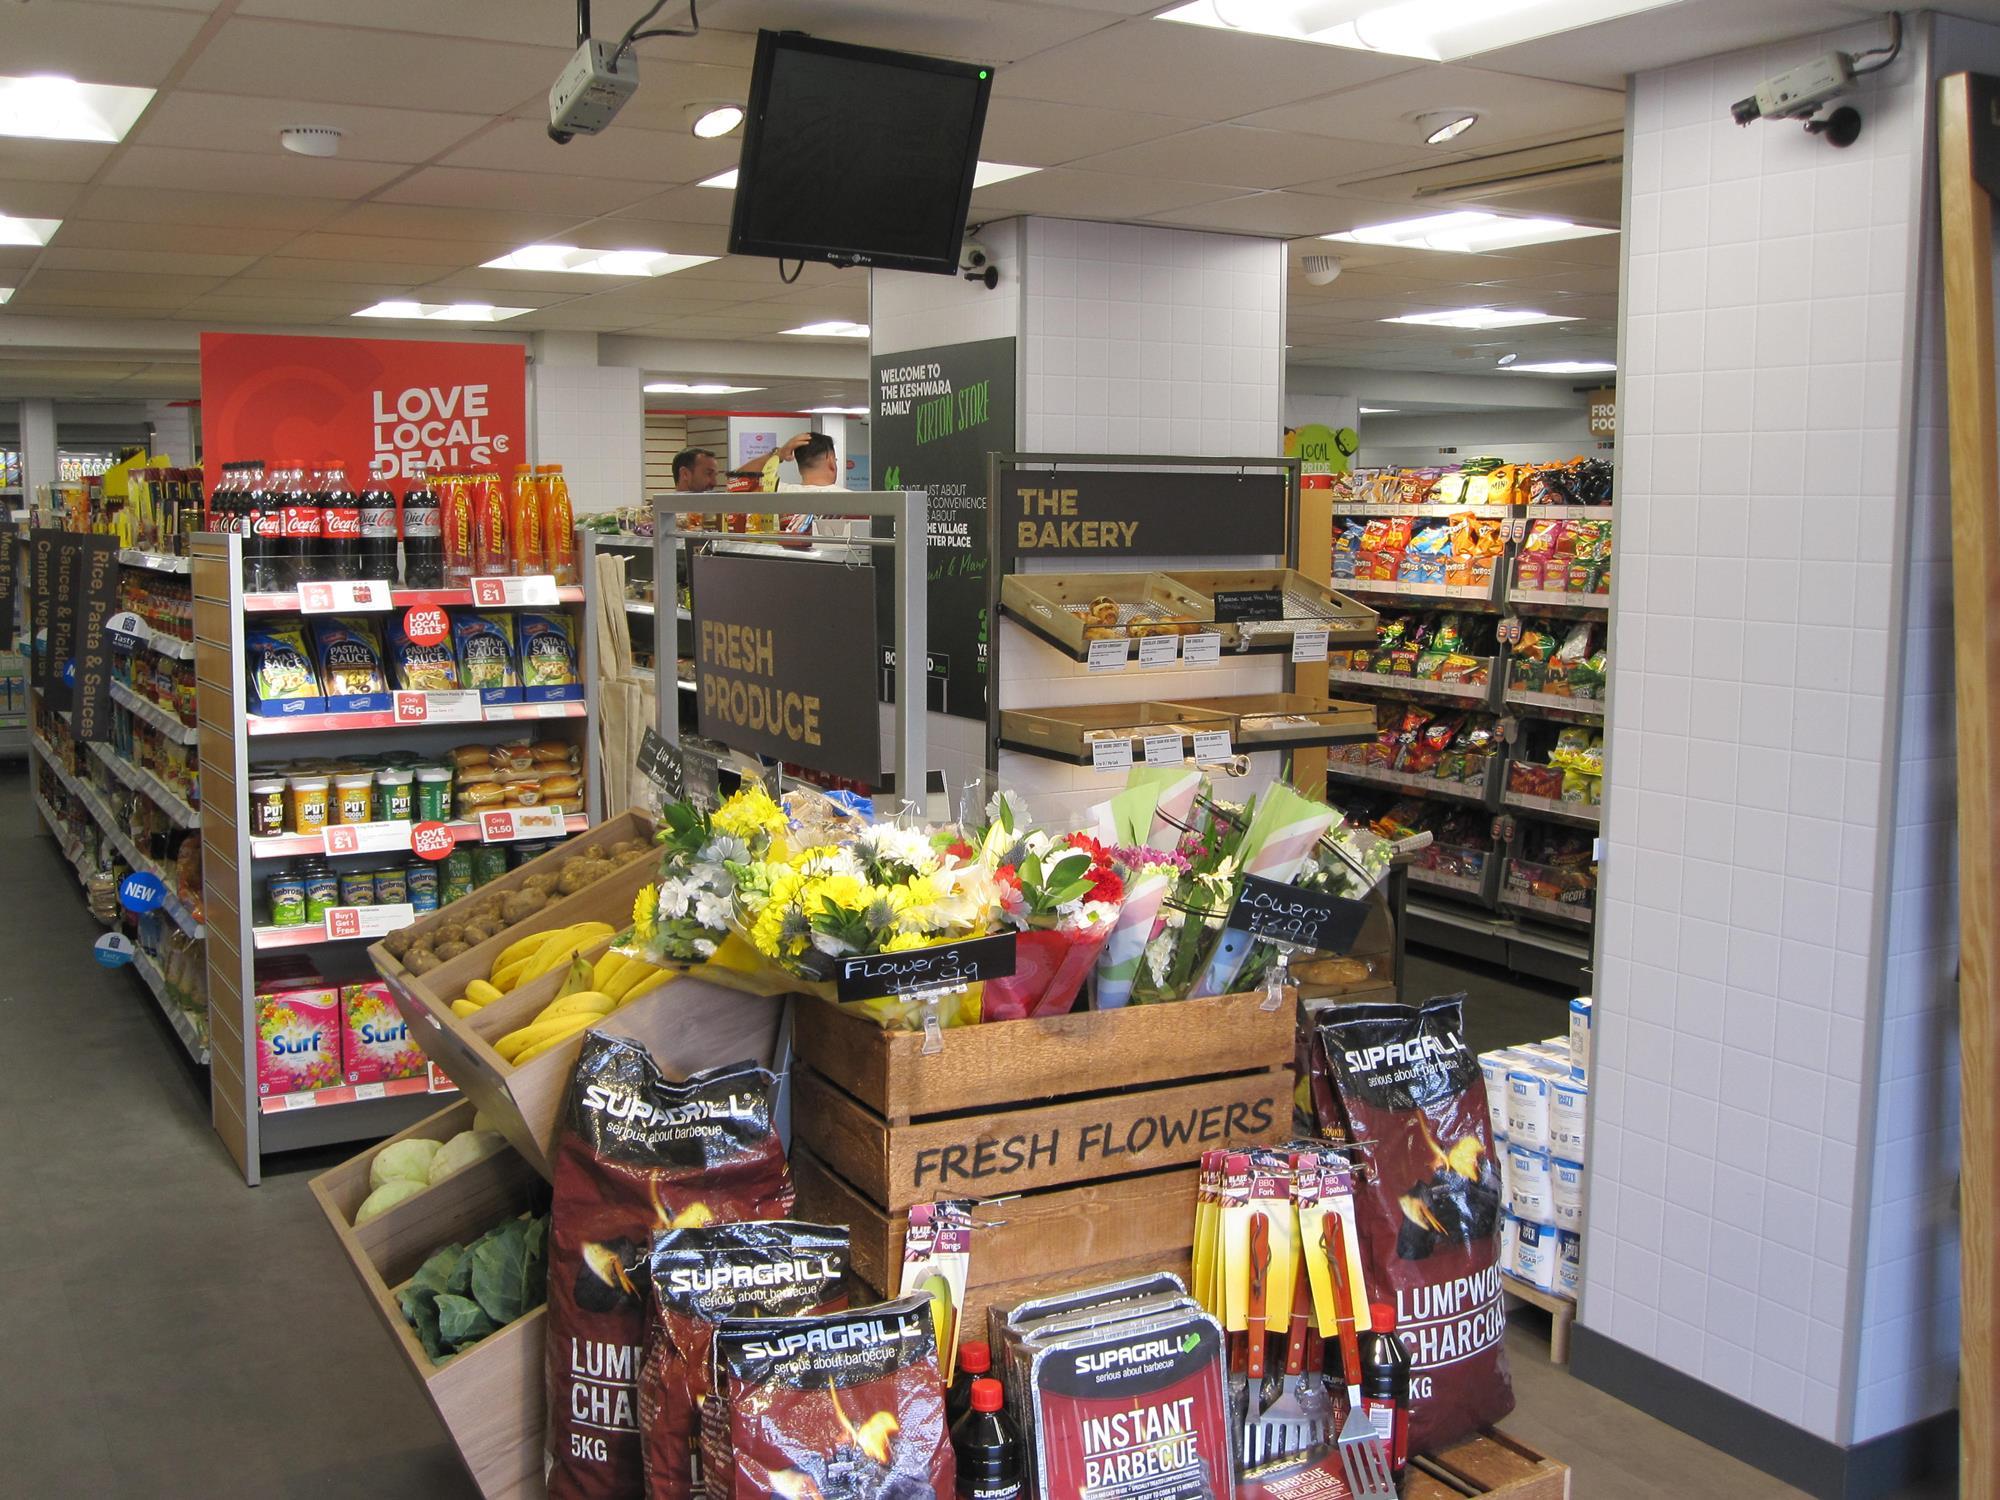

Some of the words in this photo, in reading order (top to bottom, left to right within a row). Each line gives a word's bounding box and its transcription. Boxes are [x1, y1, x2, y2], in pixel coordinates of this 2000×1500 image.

[880, 365, 926, 384] WELCOME
[927, 363, 940, 379] TO
[880, 384, 898, 400] THE
[900, 380, 952, 398] KESHWARA
[373, 384, 489, 424] LOVE
[881, 400, 912, 416] FAMILY
[1592, 404, 1616, 416] FRO
[916, 394, 954, 446] KIRTON
[958, 380, 990, 431] STORE
[1592, 418, 1616, 431] FOO
[374, 418, 490, 452] LOCAL
[1302, 443, 1330, 462] LOCAL
[1302, 462, 1330, 473] PRIDE
[941, 484, 966, 496] ABOUT
[932, 497, 987, 509] CONVENIENCE
[1017, 488, 1079, 516] THE
[932, 510, 956, 522] ABOUT
[926, 523, 937, 534] HE
[938, 523, 968, 534] VILLAGE
[1018, 521, 1140, 548] BAKERY
[948, 536, 972, 548] PLACE
[58, 546, 76, 602] Sauces
[482, 590, 500, 602] £1
[57, 608, 72, 618] &
[409, 611, 441, 622] LOVE
[86, 600, 106, 650] Pasta
[410, 620, 442, 629] LOCAL
[410, 626, 442, 638] DEALS
[114, 633, 136, 646] Tasty
[468, 637, 495, 647] PASTA
[532, 637, 560, 647] PASTA
[330, 645, 358, 655] PASTA
[468, 646, 506, 658] SAUCE
[702, 620, 774, 677] FRESH
[84, 655, 102, 668] &
[330, 653, 371, 664] SAUCE
[406, 652, 444, 664] SAUCE
[80, 673, 102, 738] Sauces
[401, 705, 424, 717] 75p
[703, 672, 822, 746] PRODUCE
[304, 802, 325, 814] POT
[344, 800, 366, 812] POT
[392, 796, 410, 808] POT
[264, 804, 282, 817] POT
[414, 827, 446, 840] LOVE
[488, 825, 512, 834] £1.50
[334, 836, 352, 849] £1
[416, 835, 446, 846] LOCAL
[417, 842, 448, 853] DEALS
[124, 882, 156, 902] NEW
[334, 912, 348, 921] Buy
[336, 926, 356, 934] Free
[361, 1022, 408, 1044] Surf
[272, 1032, 323, 1056] Surf
[1368, 1073, 1393, 1088] serious
[1394, 1066, 1420, 1082] about
[582, 1084, 755, 1128] SUPAGRILL
[606, 1122, 646, 1142] serious
[650, 1130, 673, 1144] about
[674, 1124, 722, 1140] barbecue
[914, 1128, 1059, 1188] FRESH
[1078, 1098, 1275, 1162] FLOWERS
[1258, 1178, 1275, 1188] BBQ
[1324, 1176, 1339, 1184] BBQ
[1258, 1188, 1275, 1196] Fork
[1325, 1186, 1348, 1195] Spatula
[941, 1232, 957, 1240] BBQ
[940, 1242, 961, 1252] Tongs
[1518, 1254, 1537, 1264] SUGAR
[670, 1258, 842, 1293] SUPAGRILL
[699, 1293, 736, 1308] serious
[738, 1290, 766, 1303] about
[770, 1284, 818, 1300] barbecue
[1396, 1260, 1502, 1323] LUMPWOO
[742, 1316, 922, 1360] SUPAGRILL
[774, 1358, 812, 1374] serious
[814, 1354, 843, 1369] about
[845, 1346, 896, 1366] barbecue
[1075, 1336, 1186, 1374] SUPAGRILL
[1096, 1368, 1121, 1384] serious
[1122, 1366, 1142, 1378] about
[1144, 1358, 1175, 1373] barbecue
[1082, 1396, 1194, 1455] INSTANT
[570, 1434, 608, 1462] 5KG
[1086, 1437, 1199, 1489] BARBECUE
[1262, 1466, 1330, 1494] BARBECUE
[974, 1481, 1022, 1498] SUPAGRILL
[1276, 1476, 1342, 1500] FIRELIGHTERS
